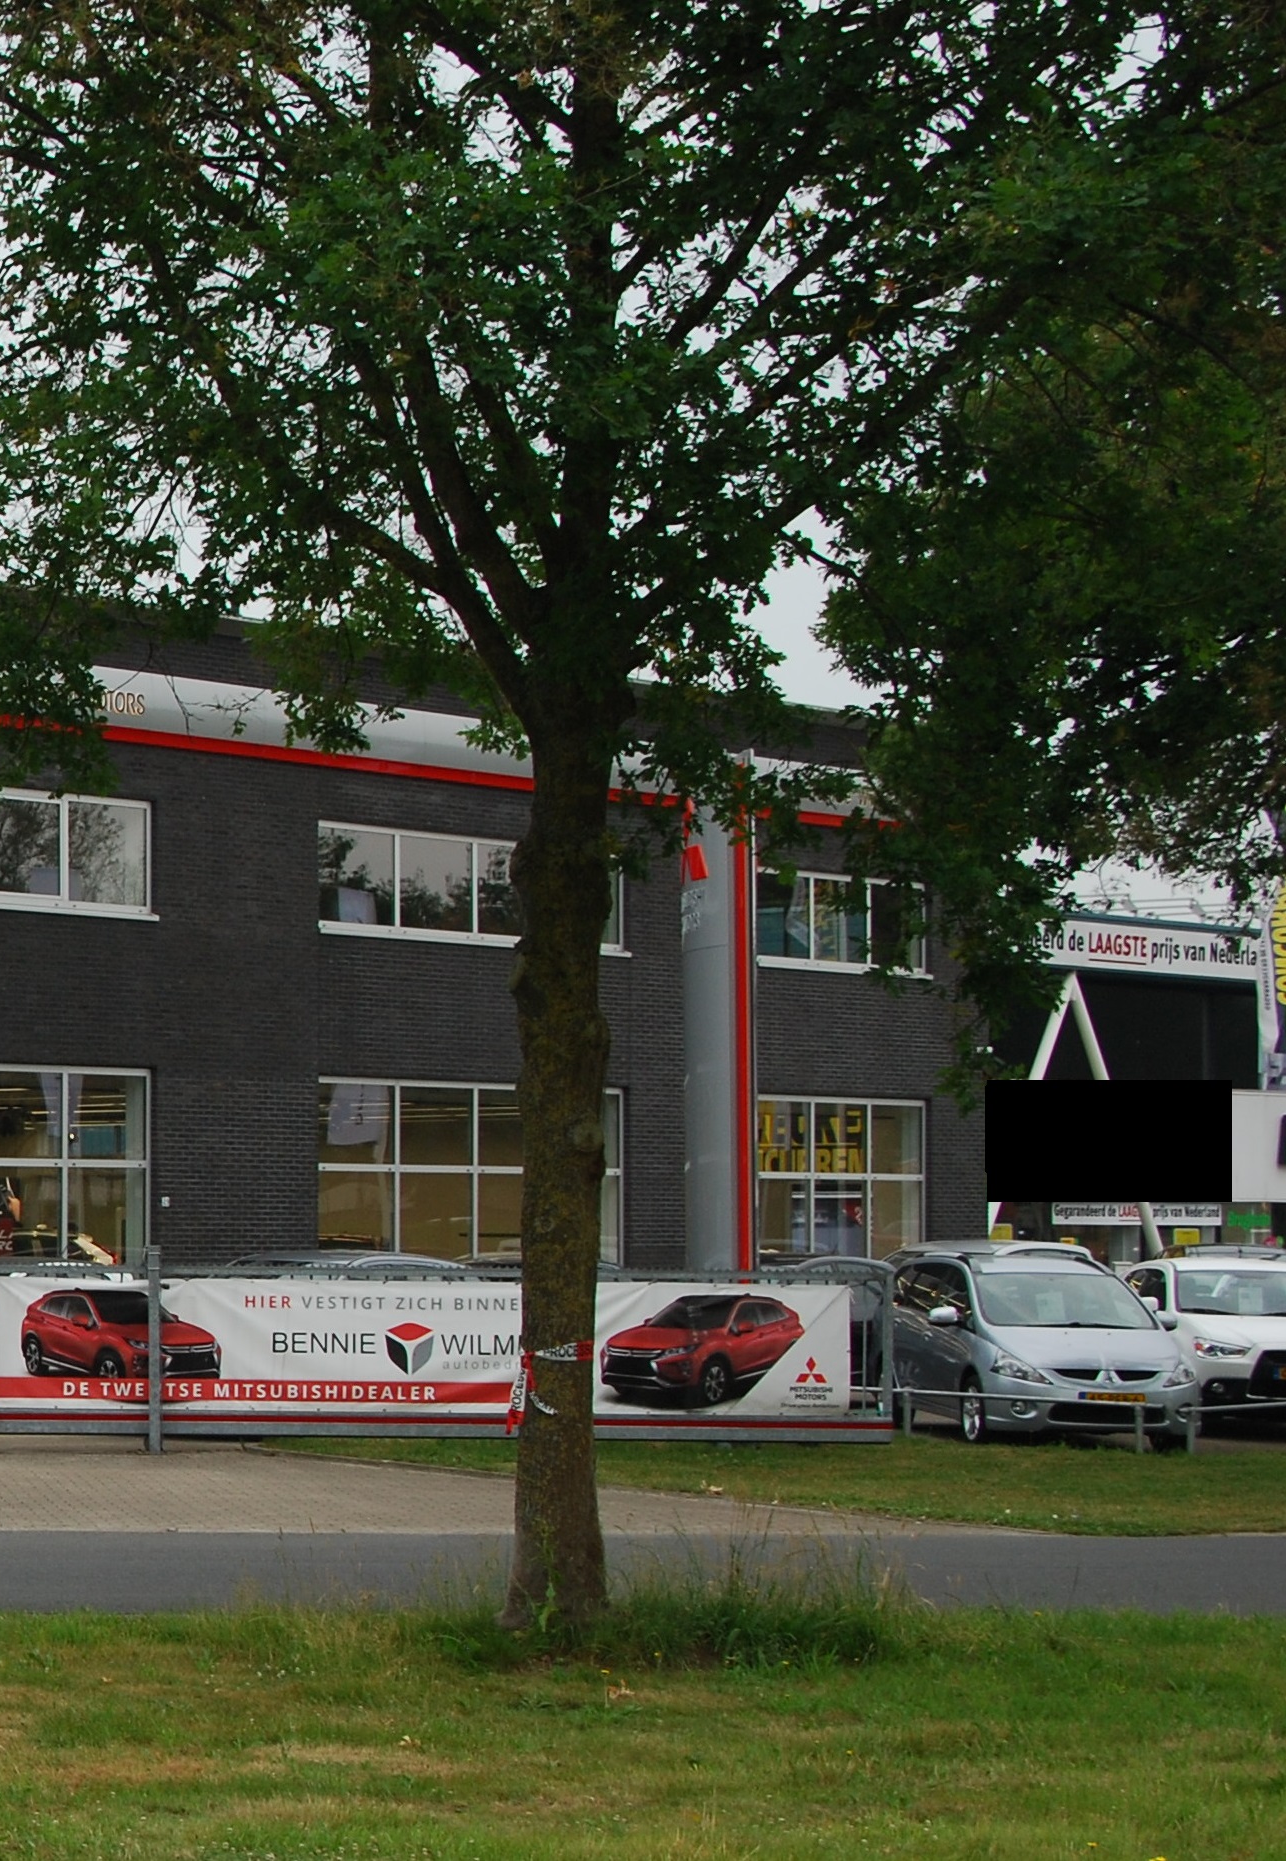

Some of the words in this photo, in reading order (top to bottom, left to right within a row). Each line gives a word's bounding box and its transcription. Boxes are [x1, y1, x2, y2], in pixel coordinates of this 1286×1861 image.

[1068, 929, 1084, 952] de
[1088, 931, 1147, 958] LAAGSTE
[1151, 936, 1180, 965] prijs
[1183, 944, 1206, 962] van
[1054, 1204, 1106, 1220] Gegarandeerd
[1107, 1204, 1116, 1218] de
[1152, 1205, 1169, 1220] prijs
[1170, 1208, 1182, 1218] van
[1184, 1205, 1220, 1218] Nederland
[244, 1295, 292, 1309] HIER
[301, 1296, 386, 1310] VESTIGT
[395, 1297, 443, 1311] ZICH
[454, 1298, 519, 1311] BINNE
[271, 1331, 377, 1355] BENNIE
[63, 1381, 89, 1397] DE
[100, 1382, 203, 1398] TWETSE
[213, 1383, 436, 1400] MITSUBISHIDEALER
